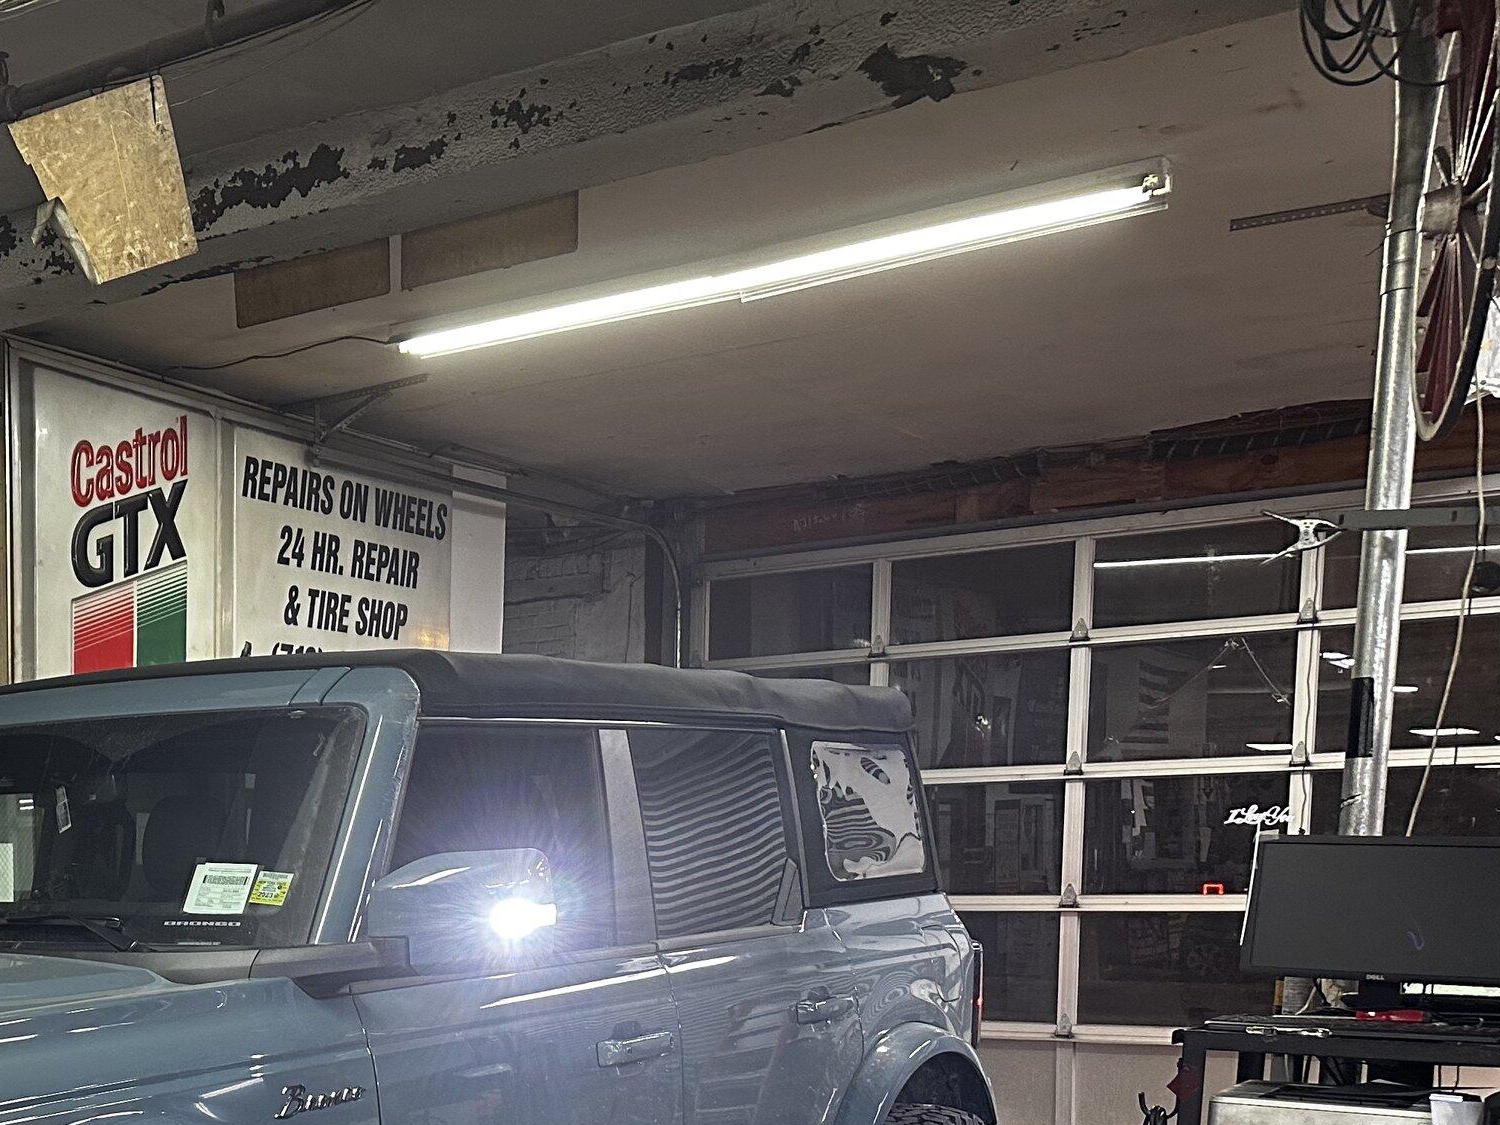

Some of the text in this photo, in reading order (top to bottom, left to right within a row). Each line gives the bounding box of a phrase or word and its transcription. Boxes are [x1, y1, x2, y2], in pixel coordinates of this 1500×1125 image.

[71, 415, 188, 508] Castrol
[242, 456, 448, 541] REPAIRS ON WHEELS
[71, 479, 188, 588] GTX
[276, 525, 420, 589] 24 HR. REPAIR
[284, 585, 408, 640] & TIRE SHOP
